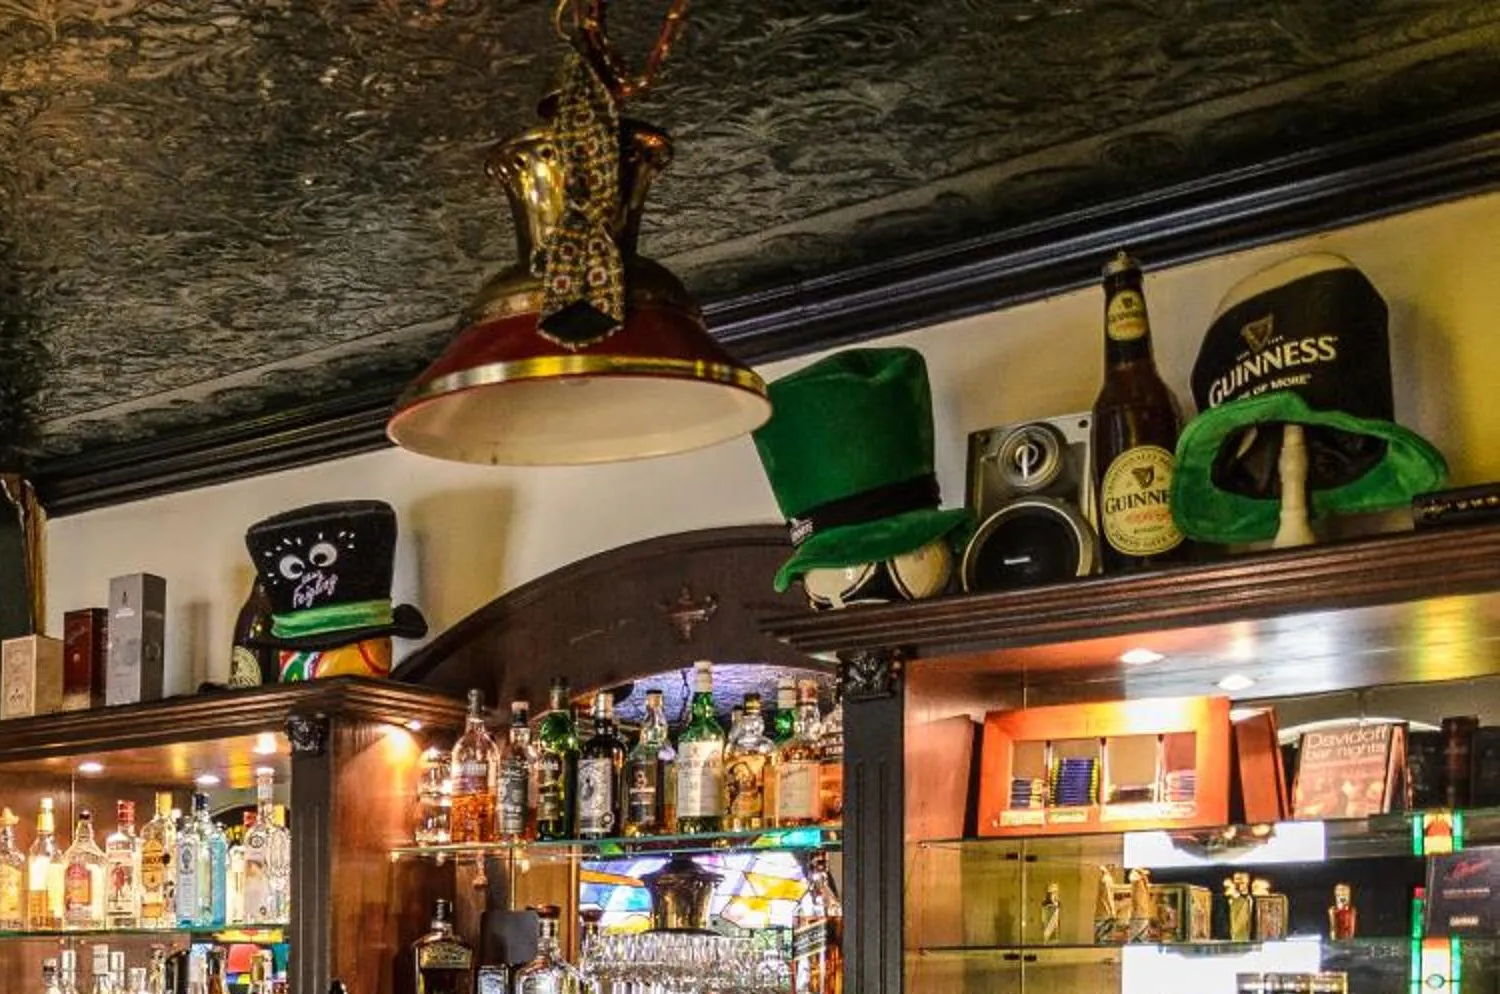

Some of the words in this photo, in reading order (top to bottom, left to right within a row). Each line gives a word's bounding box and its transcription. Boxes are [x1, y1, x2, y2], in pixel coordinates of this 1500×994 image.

[1209, 336, 1338, 409] GUINNESS
[1271, 373, 1309, 389] MORE
[1106, 489, 1171, 515] GUINNE
[1308, 726, 1385, 749] Davidoff
